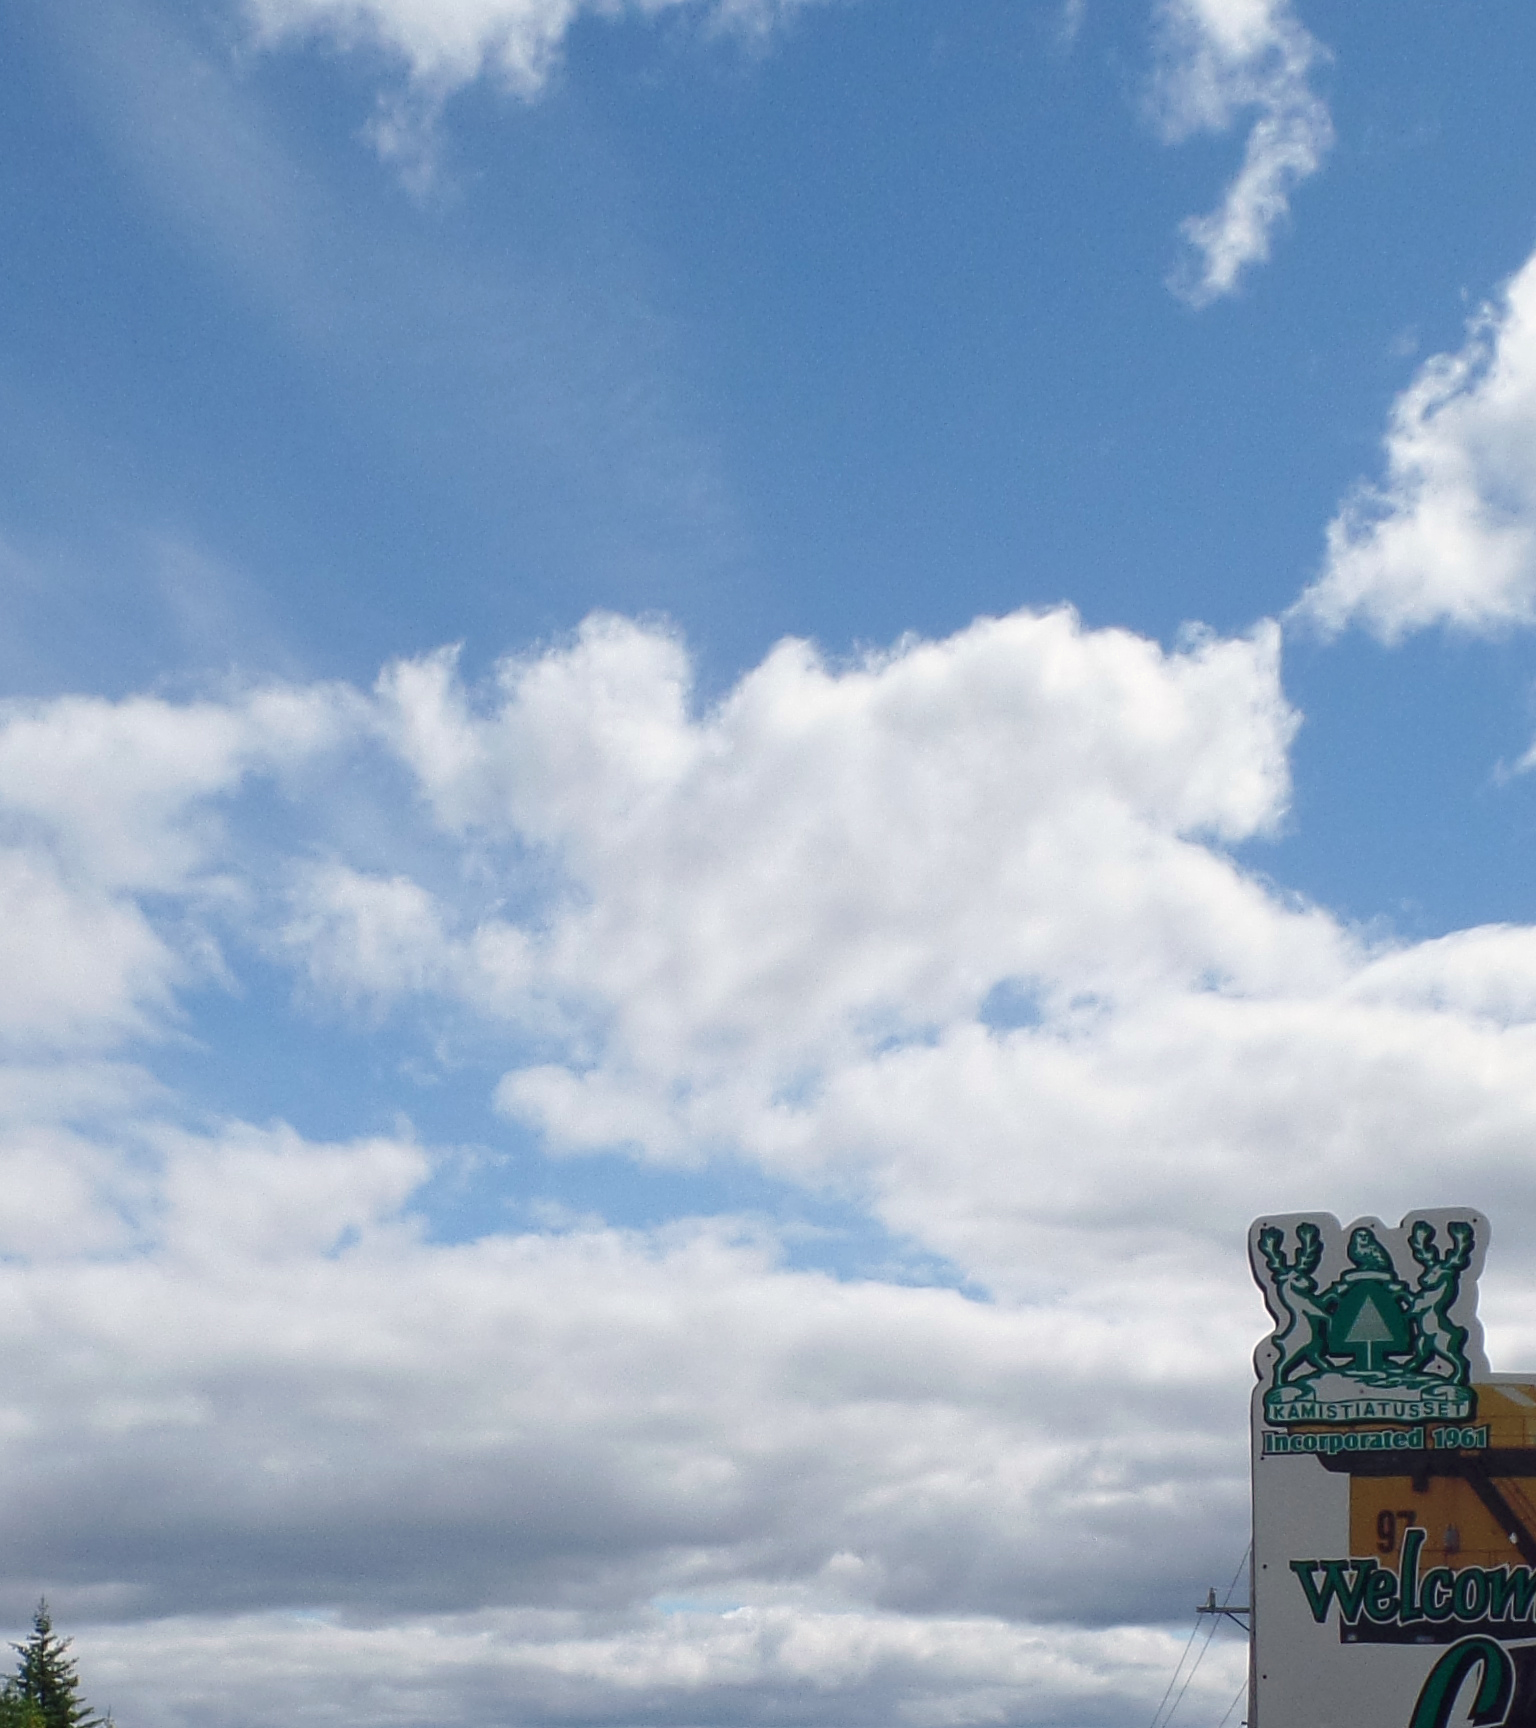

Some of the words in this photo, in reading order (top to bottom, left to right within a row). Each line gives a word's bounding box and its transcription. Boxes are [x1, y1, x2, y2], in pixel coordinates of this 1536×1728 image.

[1272, 1401, 1465, 1420] KAMISTIATUSSET
[1264, 1426, 1425, 1455] Incorporated
[1431, 1424, 1489, 1450] 1961
